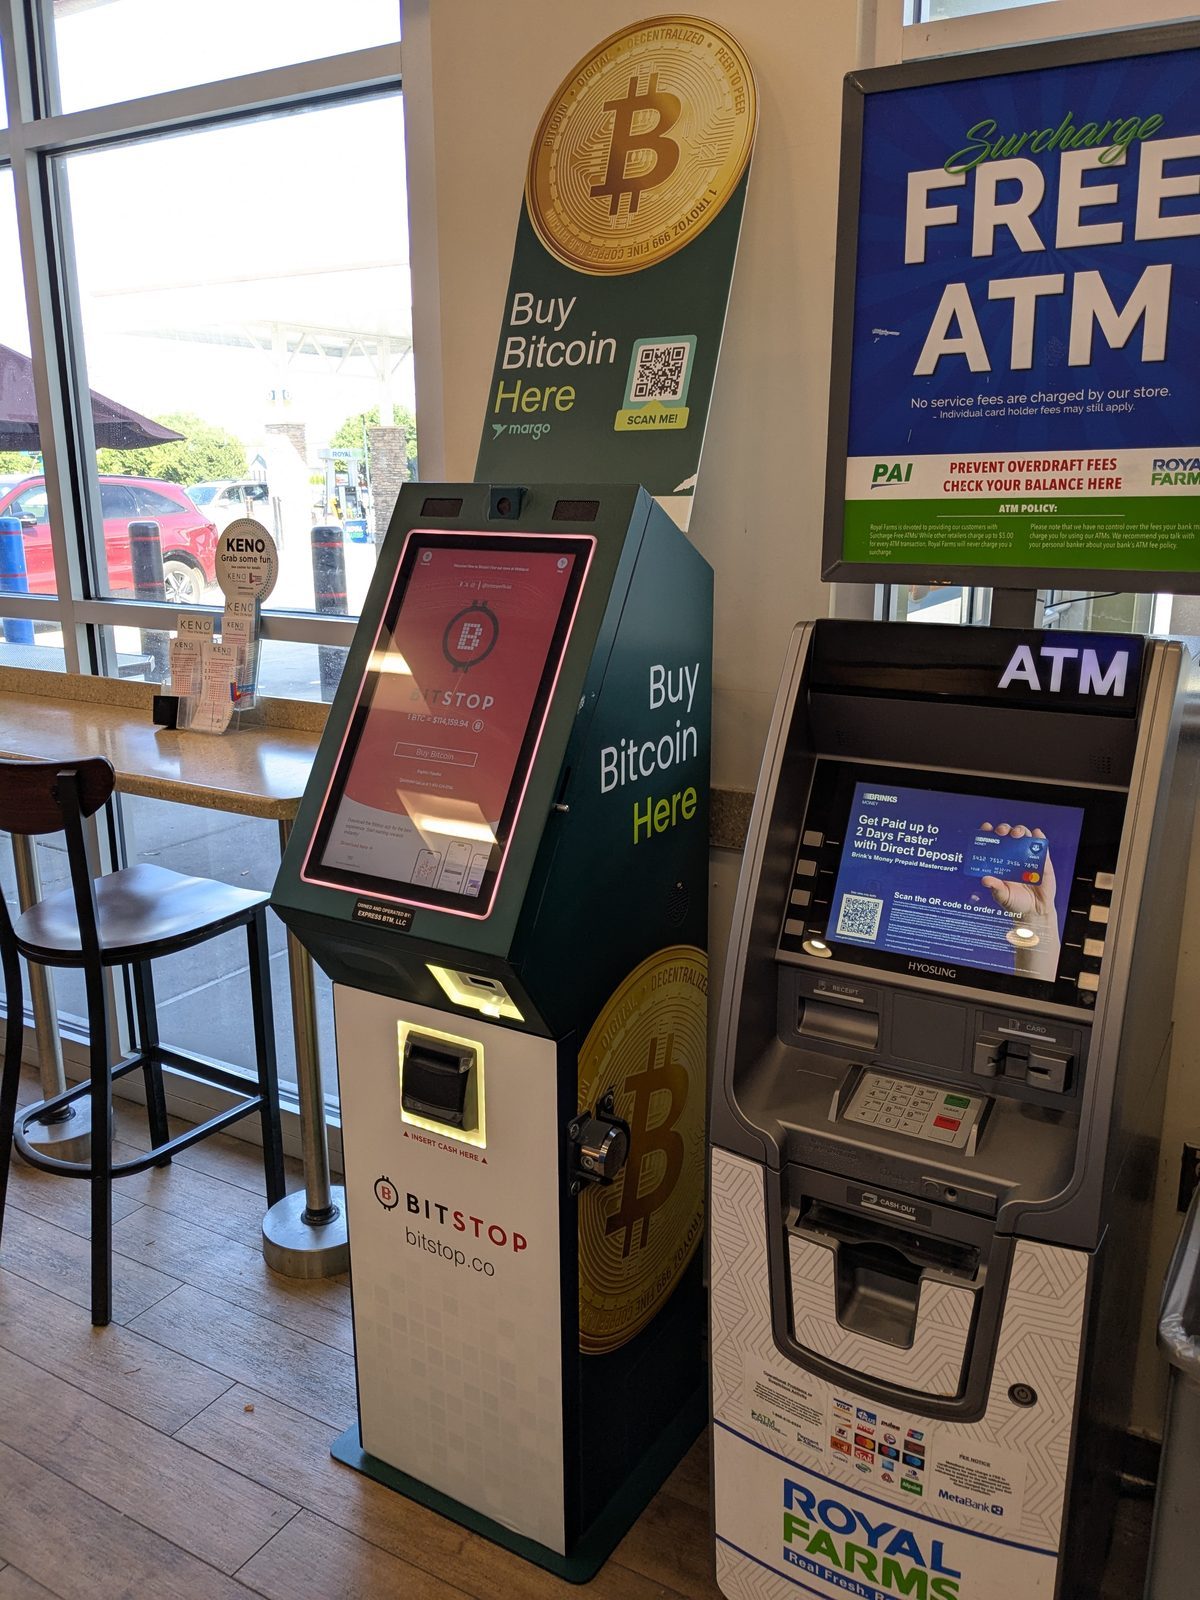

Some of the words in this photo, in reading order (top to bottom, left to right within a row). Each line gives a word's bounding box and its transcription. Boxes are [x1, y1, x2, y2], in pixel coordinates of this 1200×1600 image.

[627, 28, 705, 46] DECENTRALIZED
[576, 53, 610, 86] DIGITAL
[714, 47, 735, 73] PEER
[729, 69, 742, 86] TO
[733, 86, 746, 116] PEER
[544, 103, 568, 147] BITCOIN
[944, 112, 1164, 175] Surcharge
[904, 134, 1200, 265] FREE
[652, 231, 670, 249] 999
[627, 242, 649, 258] FINE
[510, 292, 577, 331] Buy
[912, 263, 1173, 376] ATM
[501, 331, 617, 370] Bitcoin
[494, 379, 576, 413] Here
[911, 398, 928, 409] No
[930, 395, 975, 408] service
[977, 394, 1003, 406] fees
[1006, 395, 1027, 404] are
[1030, 389, 1084, 406] charged
[1088, 388, 1105, 402] by
[1107, 389, 1130, 400] our
[1133, 386, 1172, 398] store.
[626, 414, 657, 425] SCAN
[658, 414, 679, 424] ME!
[939, 408, 983, 419] Individual
[985, 407, 1006, 418] card
[1007, 405, 1039, 416] holder
[1040, 404, 1061, 415] fees
[1063, 405, 1084, 415] may
[1086, 402, 1104, 412] still
[1105, 402, 1136, 413] apply.
[508, 423, 551, 440] margo
[872, 463, 913, 483] PAI
[950, 460, 1005, 474] PREVENT
[1007, 459, 1085, 473] OVERDRAFT
[1086, 458, 1118, 471] FEES
[943, 479, 983, 492] CHECK
[986, 478, 1022, 491] YOUR
[1025, 478, 1084, 490] BALANCE
[1087, 477, 1122, 490] HERE
[999, 504, 1020, 513] ATM
[1021, 503, 1058, 513] POLICY:
[226, 538, 265, 553] KENO
[221, 554, 238, 562] Grab
[239, 555, 258, 563] some
[260, 555, 273, 564] fun.
[226, 601, 254, 612] KENO
[180, 620, 211, 630] KENO
[997, 645, 1129, 697] ATM
[650, 663, 700, 713] Buy
[412, 714, 426, 722] BTC
[416, 748, 429, 758] Buy
[430, 750, 454, 760] Bitcoin
[601, 719, 697, 794] Bitcoin
[633, 786, 697, 845] Here
[858, 814, 879, 826] Get
[881, 817, 907, 830] Paid
[909, 823, 924, 834] up
[927, 824, 939, 834] to
[856, 826, 864, 836] 2
[866, 827, 894, 841] Days
[851, 852, 872, 860] Brink's
[873, 855, 894, 863] Money
[894, 857, 918, 867] Prepaid
[853, 840, 877, 851] with
[880, 842, 915, 856] Direct
[917, 847, 963, 863] Deposit
[357, 902, 372, 910] OWNED
[382, 906, 404, 916] OPERATED
[894, 891, 914, 901] Scan
[914, 893, 928, 903] the
[928, 896, 941, 906] QR
[943, 899, 962, 909] code
[963, 902, 972, 911] to
[973, 904, 995, 914] order
[1003, 909, 1023, 919] card
[358, 910, 382, 921] EXPRESS
[382, 914, 395, 924] BTM,
[395, 918, 407, 926] LLC
[908, 961, 957, 978] HYOSUNG
[832, 984, 860, 995] RECEIPT
[1026, 1024, 1047, 1034] CARD
[411, 1133, 436, 1147] INSERT
[438, 1142, 458, 1155] CASH
[459, 1150, 480, 1162] HERE
[880, 1198, 900, 1209] CASH
[900, 1203, 916, 1214] OUT
[406, 1192, 528, 1253] BITSTOP
[405, 1225, 495, 1277] bitstop.co
[836, 1402, 851, 1412] VISA
[880, 1420, 900, 1431] pulse
[938, 1488, 990, 1513] MetaBank
[783, 1478, 961, 1579] ROYAL
[783, 1512, 960, 1600] FARMS
[788, 1551, 819, 1576] Real
[824, 1569, 869, 1598] Fresh.
